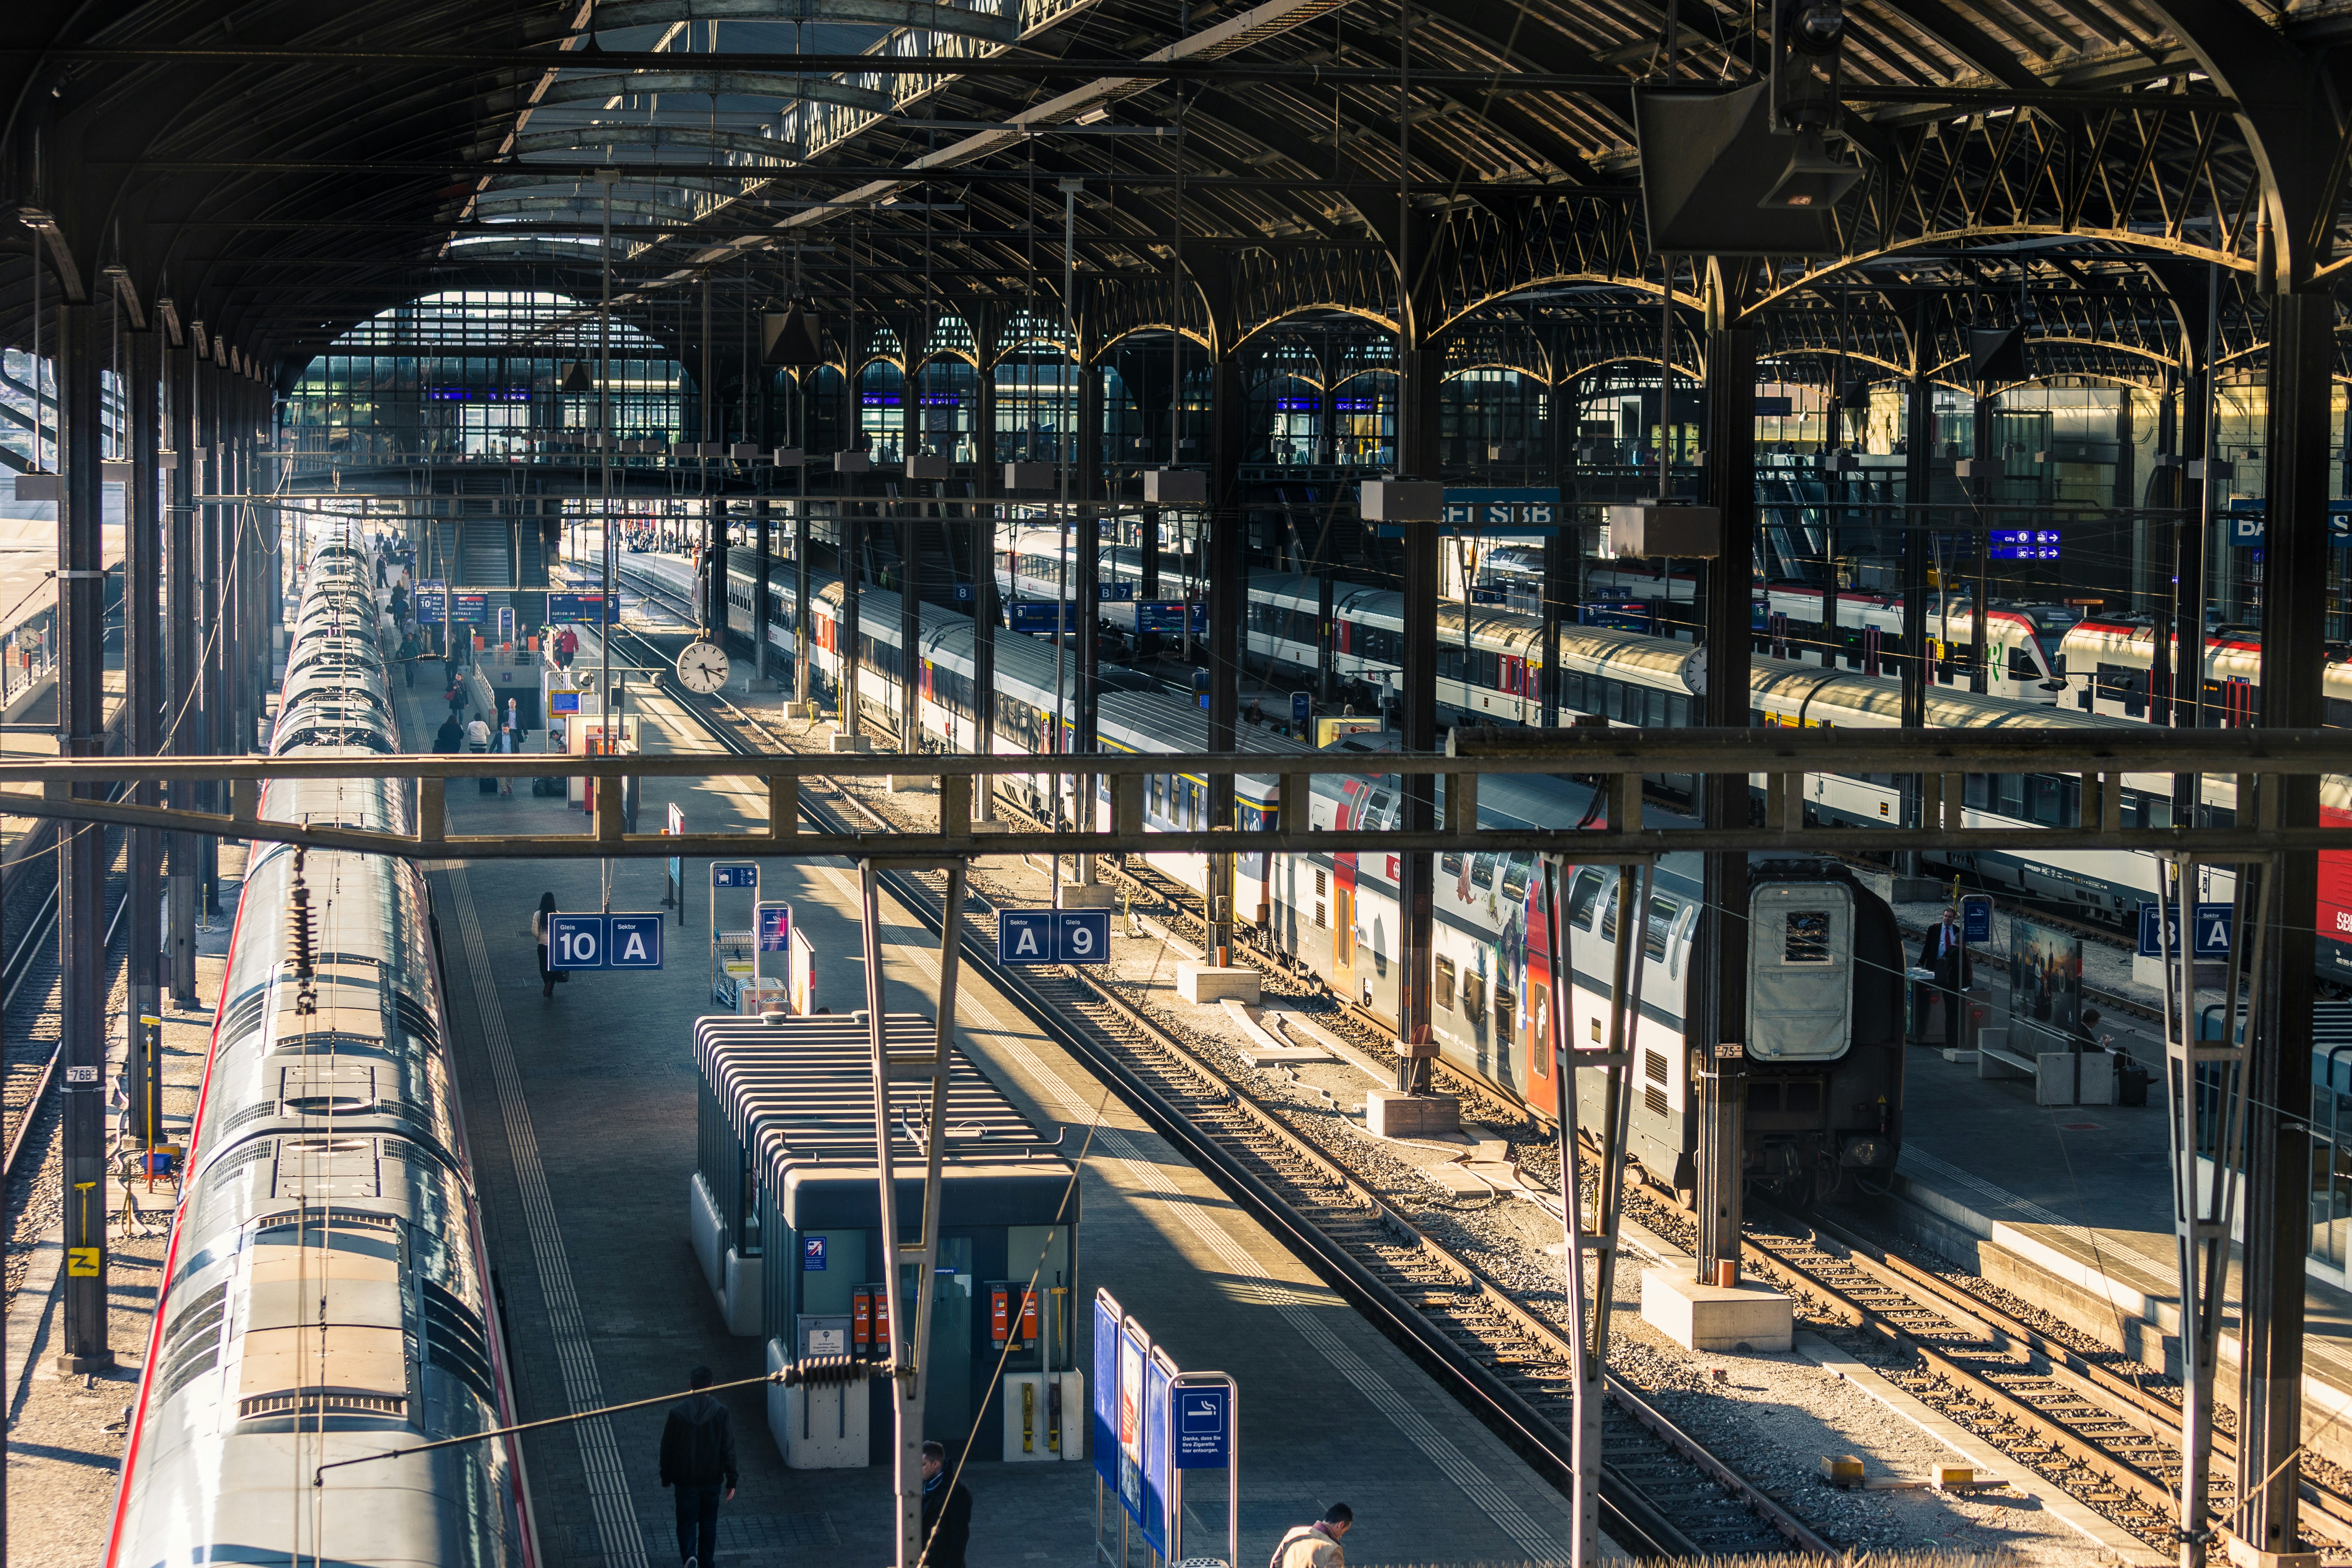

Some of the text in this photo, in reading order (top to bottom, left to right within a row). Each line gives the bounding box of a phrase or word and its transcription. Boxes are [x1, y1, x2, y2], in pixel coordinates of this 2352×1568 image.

[959, 588, 966, 597] 8
[1102, 589, 1109, 597] B
[1121, 589, 1127, 597] 7
[1477, 591, 1484, 600] 6
[1494, 591, 1501, 600] B
[1358, 814, 1363, 830] 2
[1526, 882, 1532, 900] 2
[1015, 928, 1038, 954] A
[1073, 928, 1093, 954] 9
[2207, 921, 2228, 946] A
[560, 932, 596, 960] 10
[623, 932, 646, 959] A
[1522, 965, 1526, 983] 2
[1723, 1046, 1734, 1057] 75
[73, 1070, 92, 1081] 76B
